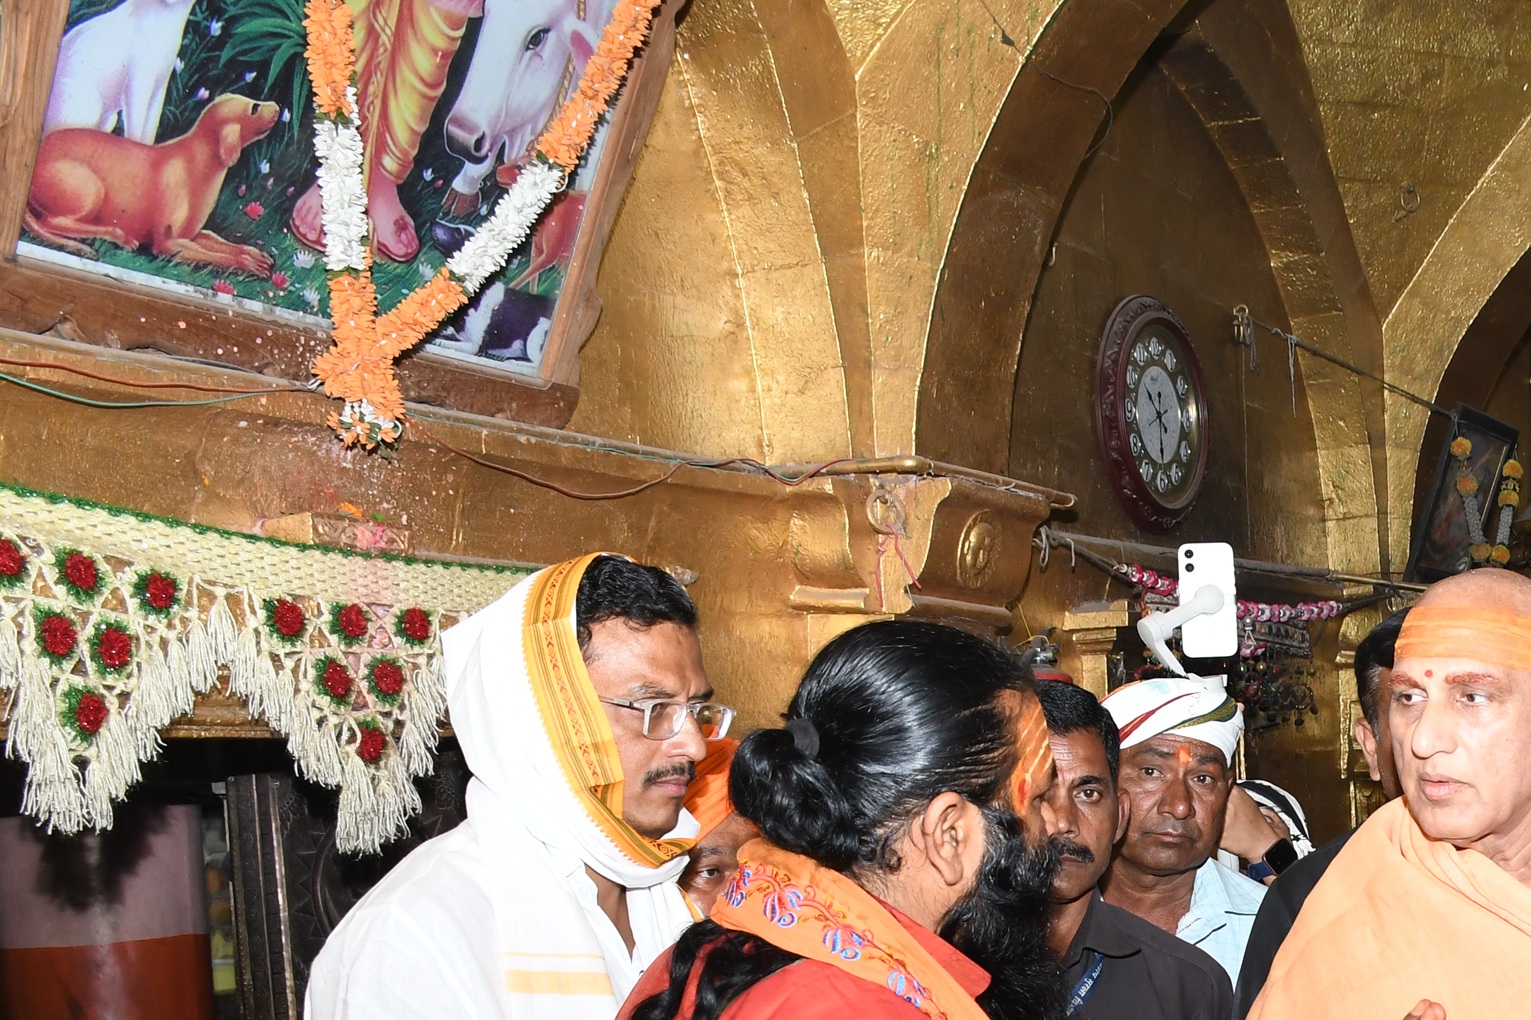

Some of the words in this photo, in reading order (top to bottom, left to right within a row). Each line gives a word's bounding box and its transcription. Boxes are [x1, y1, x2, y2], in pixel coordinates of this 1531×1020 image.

[1137, 344, 1145, 363] 11
[1152, 339, 1160, 358] 12
[1128, 367, 1136, 387] 10
[1179, 377, 1186, 397] 2
[1126, 401, 1133, 421] 9
[1132, 435, 1138, 455] 8
[1159, 472, 1165, 491] 6
[1077, 977, 1094, 998] सुरक्षा
